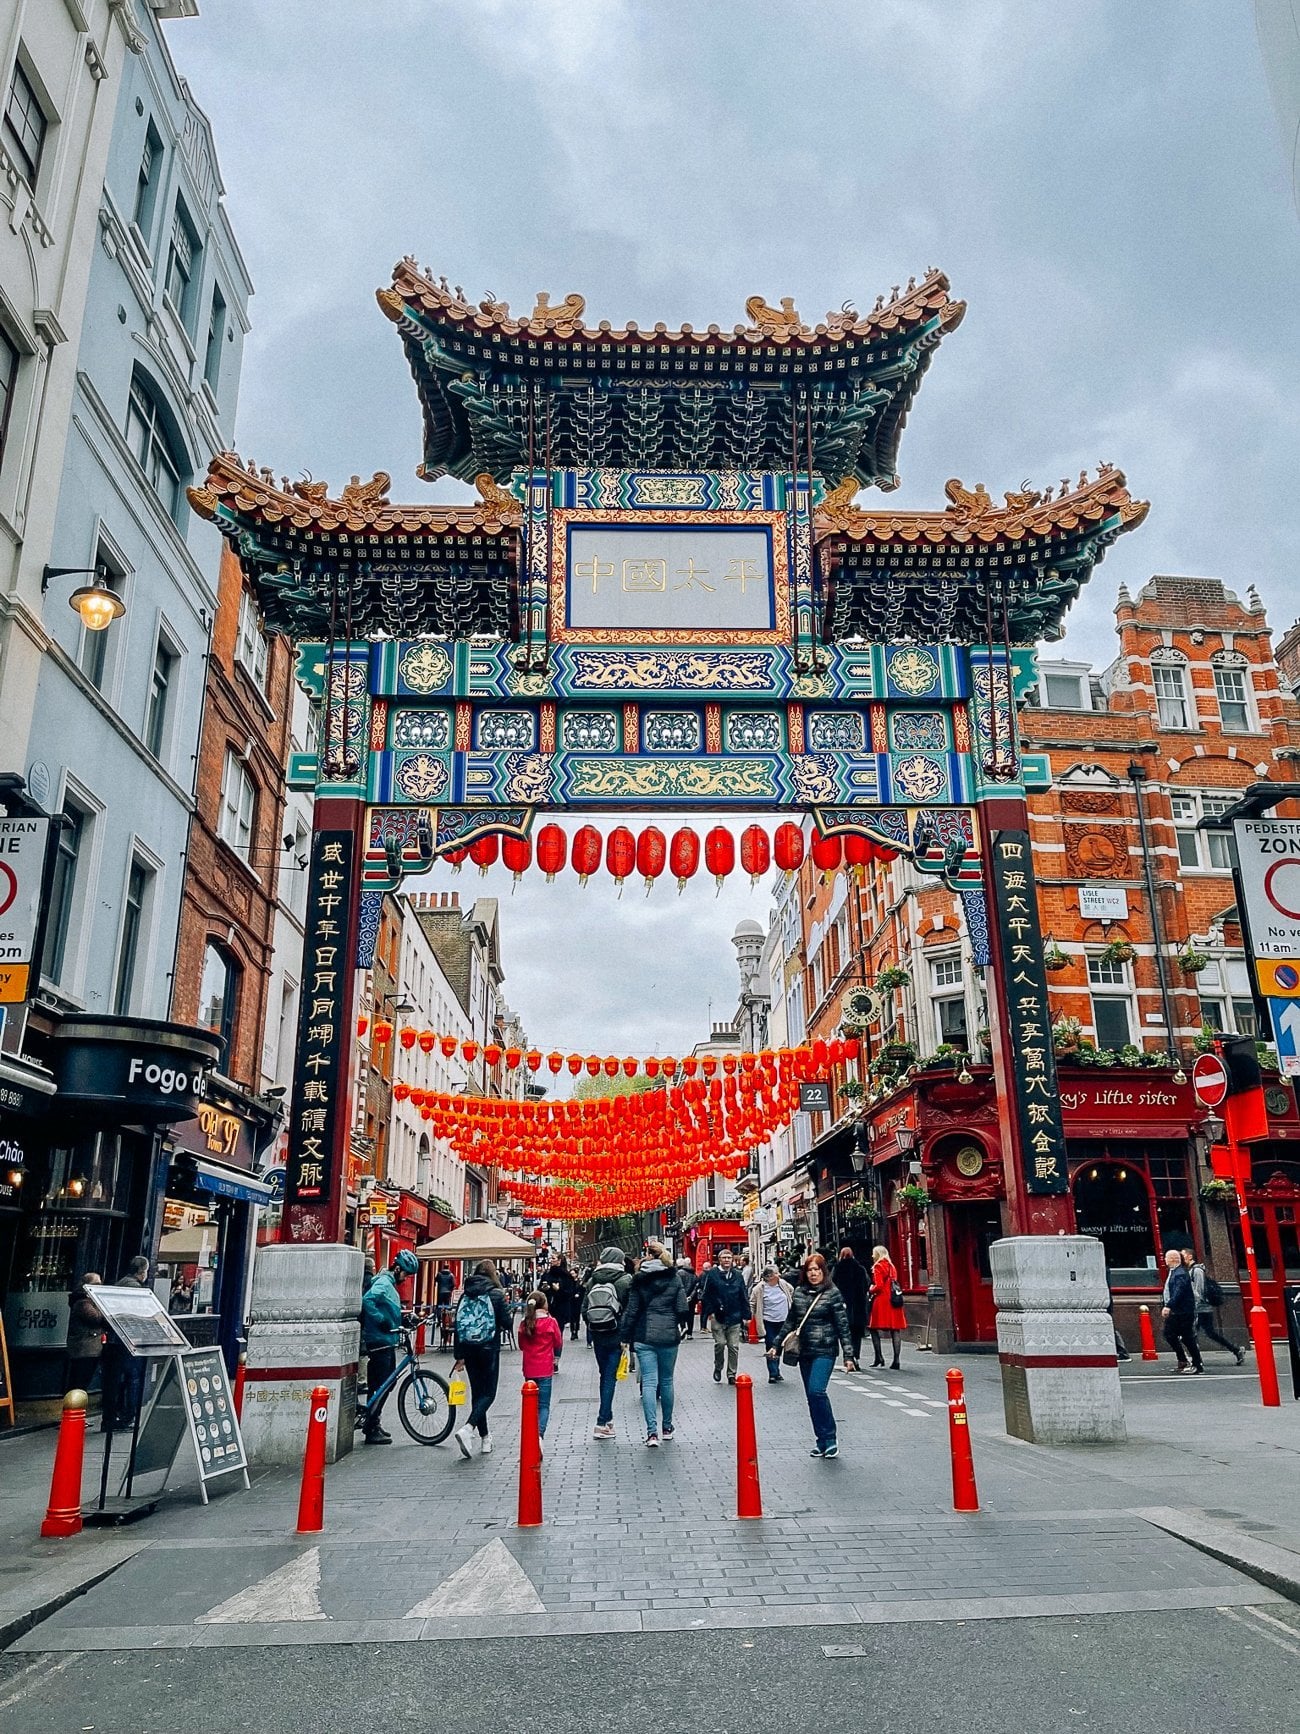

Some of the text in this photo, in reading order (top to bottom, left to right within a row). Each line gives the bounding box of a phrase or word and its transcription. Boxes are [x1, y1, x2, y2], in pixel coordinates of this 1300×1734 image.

[574, 554, 766, 596] 中國太平
[0, 823, 37, 833] RIAN
[1269, 927, 1286, 937] No
[128, 1058, 206, 1098] Fogo de
[806, 1088, 823, 1101] 22
[1138, 1090, 1178, 1106] sister
[200, 1111, 219, 1136] Old
[207, 1133, 223, 1153] Town
